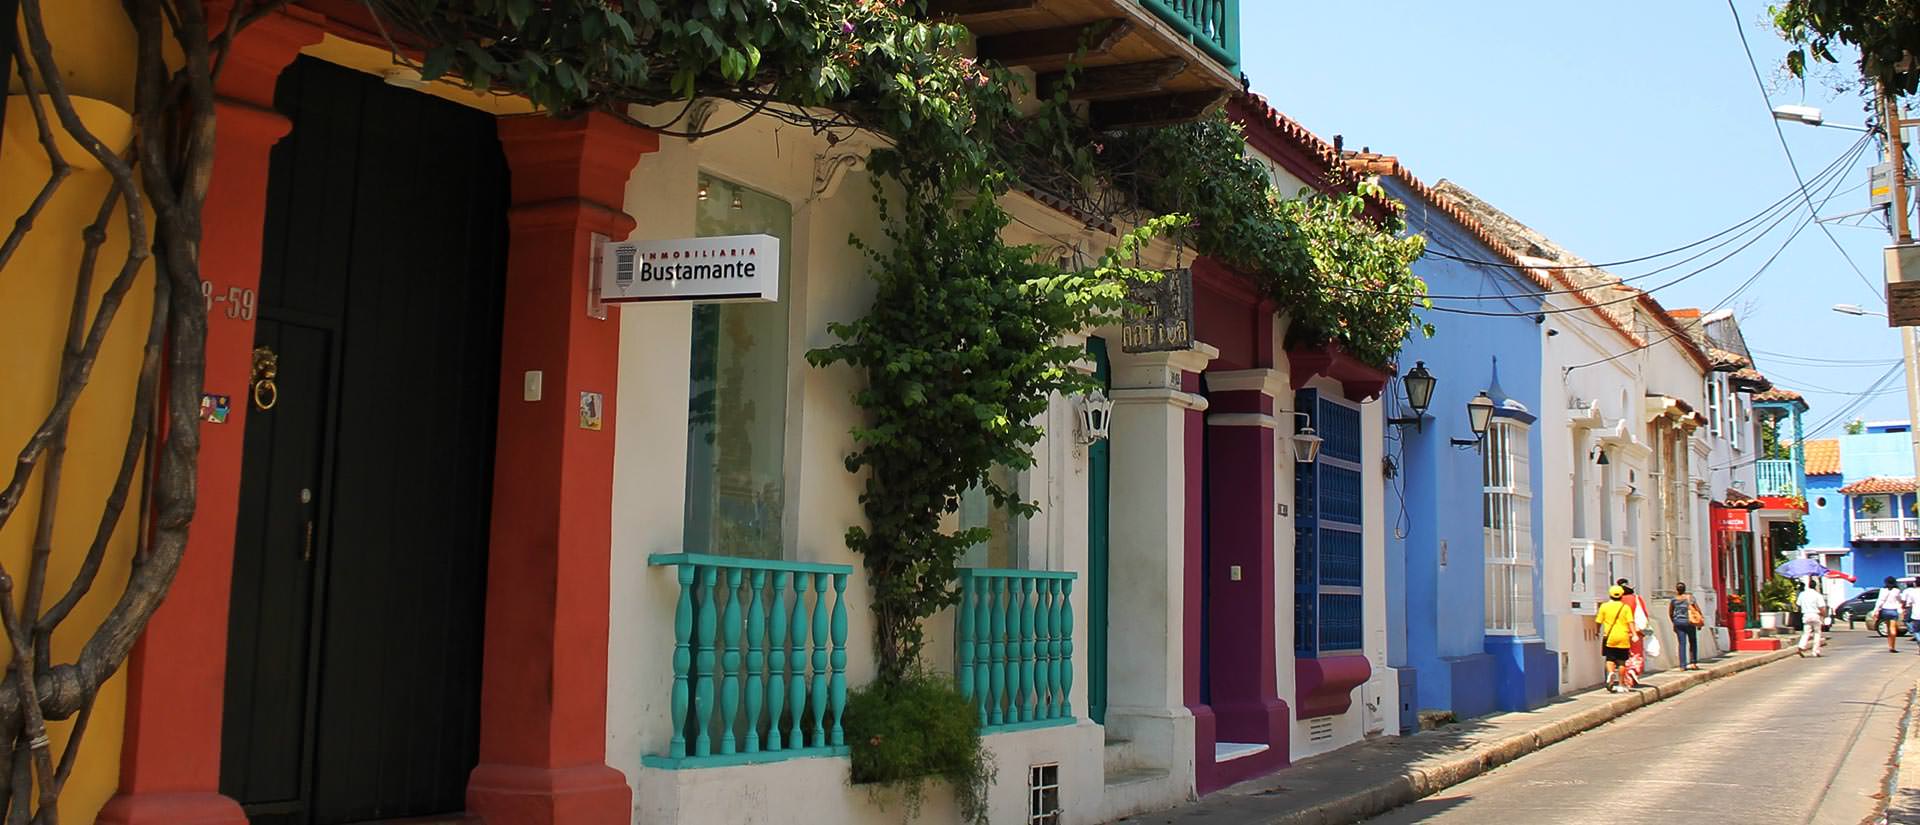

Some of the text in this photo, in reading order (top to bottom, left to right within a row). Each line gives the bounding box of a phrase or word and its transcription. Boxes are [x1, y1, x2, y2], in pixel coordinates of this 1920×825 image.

[642, 247, 757, 260] INMOBILIARIA
[640, 261, 756, 282] Bustamante
[1122, 319, 1188, 347] nativa
